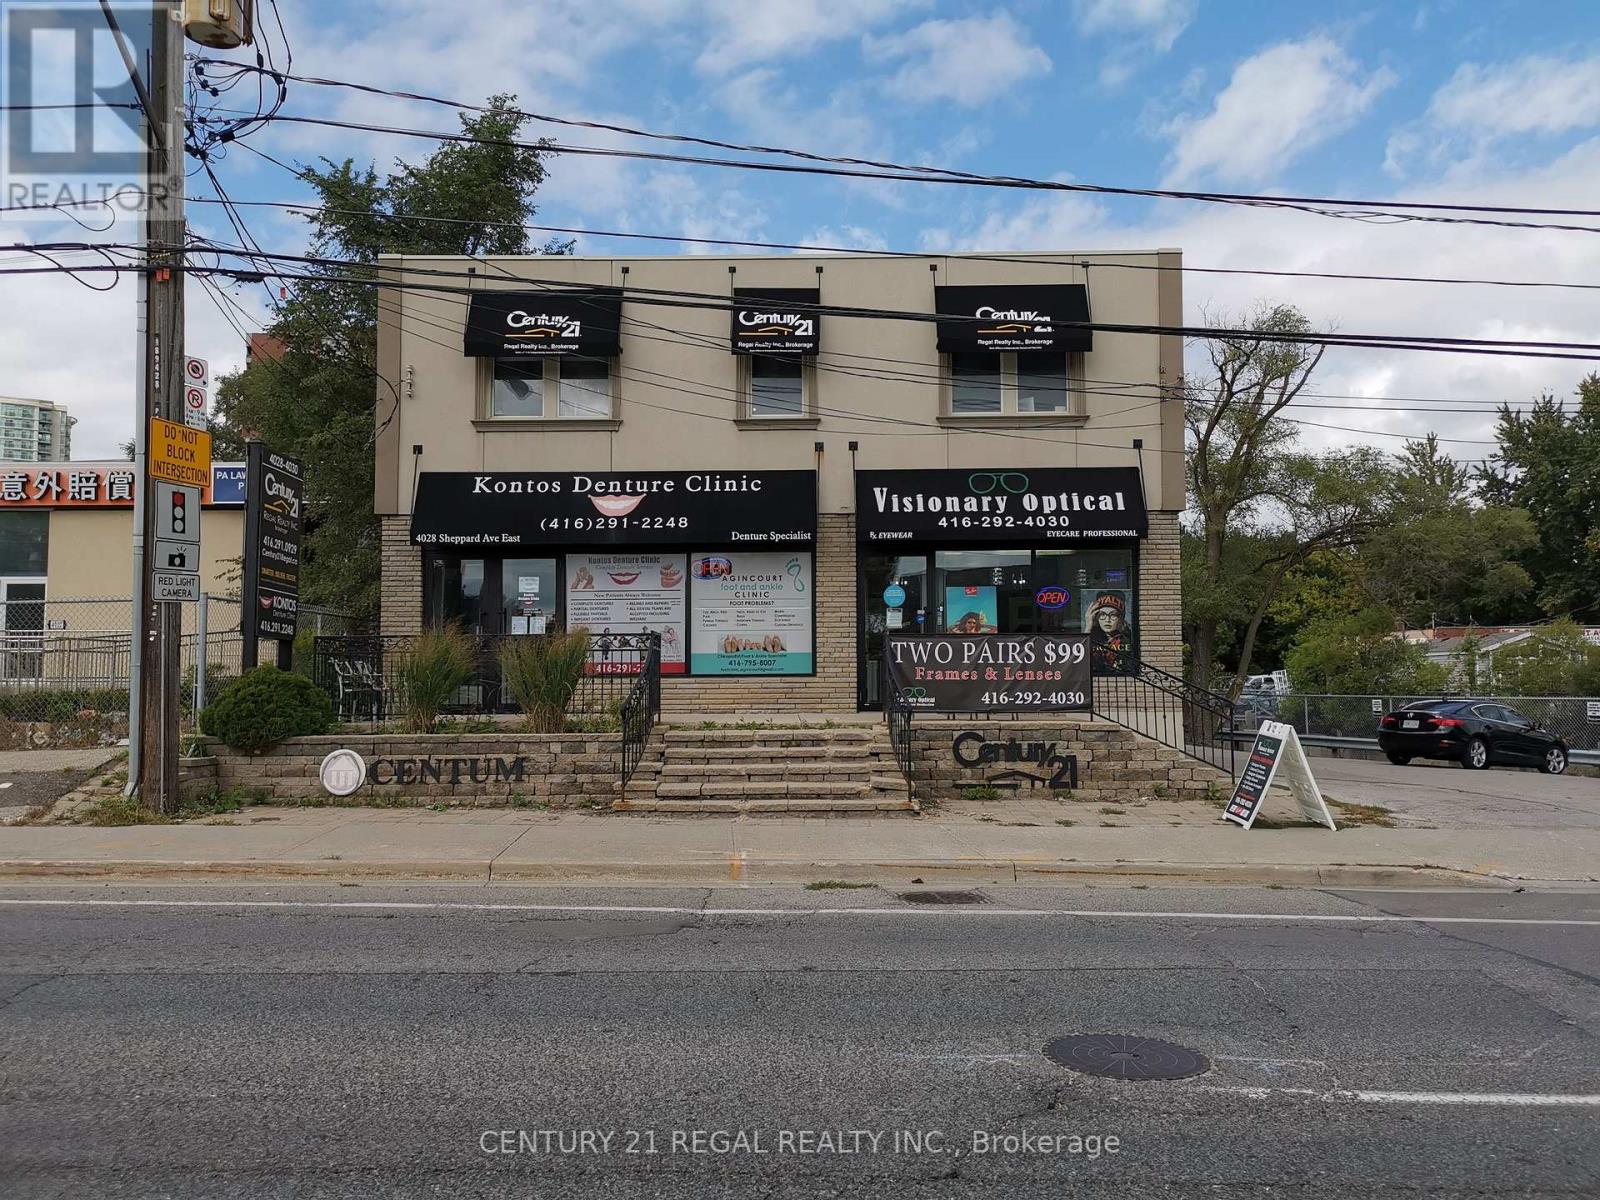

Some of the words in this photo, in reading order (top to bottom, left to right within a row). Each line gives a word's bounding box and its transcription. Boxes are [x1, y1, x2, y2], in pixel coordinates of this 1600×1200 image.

[507, 310, 569, 328] Century
[561, 320, 580, 337] 21
[738, 311, 801, 326] Century
[794, 319, 813, 335] 21
[164, 425, 177, 439] DO
[181, 429, 198, 445] NOT
[166, 443, 195, 463] BLOCK
[153, 460, 208, 483] INTERSECTION
[216, 471, 228, 480] PA
[265, 472, 295, 503] Century
[472, 476, 561, 493] Kontos
[572, 475, 675, 493] Denture
[685, 475, 762, 492] Clinic
[872, 487, 1008, 514] Visionary
[1022, 492, 1125, 514] Optical
[540, 516, 689, 531] (416)291-2248
[938, 516, 1070, 528] 416-292-4030
[415, 534, 437, 543] 4028
[439, 533, 481, 544] Sheppard
[482, 534, 499, 543] Ave
[501, 533, 520, 543] East
[731, 531, 768, 541] Denture
[769, 531, 811, 541] Specialist
[878, 531, 913, 539] EYEWEAR
[1083, 529, 1138, 537] PROFESSIONAL
[158, 576, 173, 586] RED
[175, 577, 195, 587] LIGHT
[720, 583, 738, 591] foot
[740, 582, 757, 590] and
[760, 582, 783, 590] ankle
[161, 588, 192, 598] CAMERA
[1038, 591, 1066, 604] OPEN
[891, 641, 953, 664] TWO
[962, 641, 1036, 664] PAIRS
[1044, 641, 1085, 665] $99
[915, 666, 978, 681] Frames
[984, 666, 998, 681] &
[1003, 666, 1062, 681] Lenses
[981, 691, 1085, 705] 416-292-4030
[952, 731, 1057, 768] Century
[1047, 754, 1077, 789] 21
[368, 757, 527, 784] CENTUM
